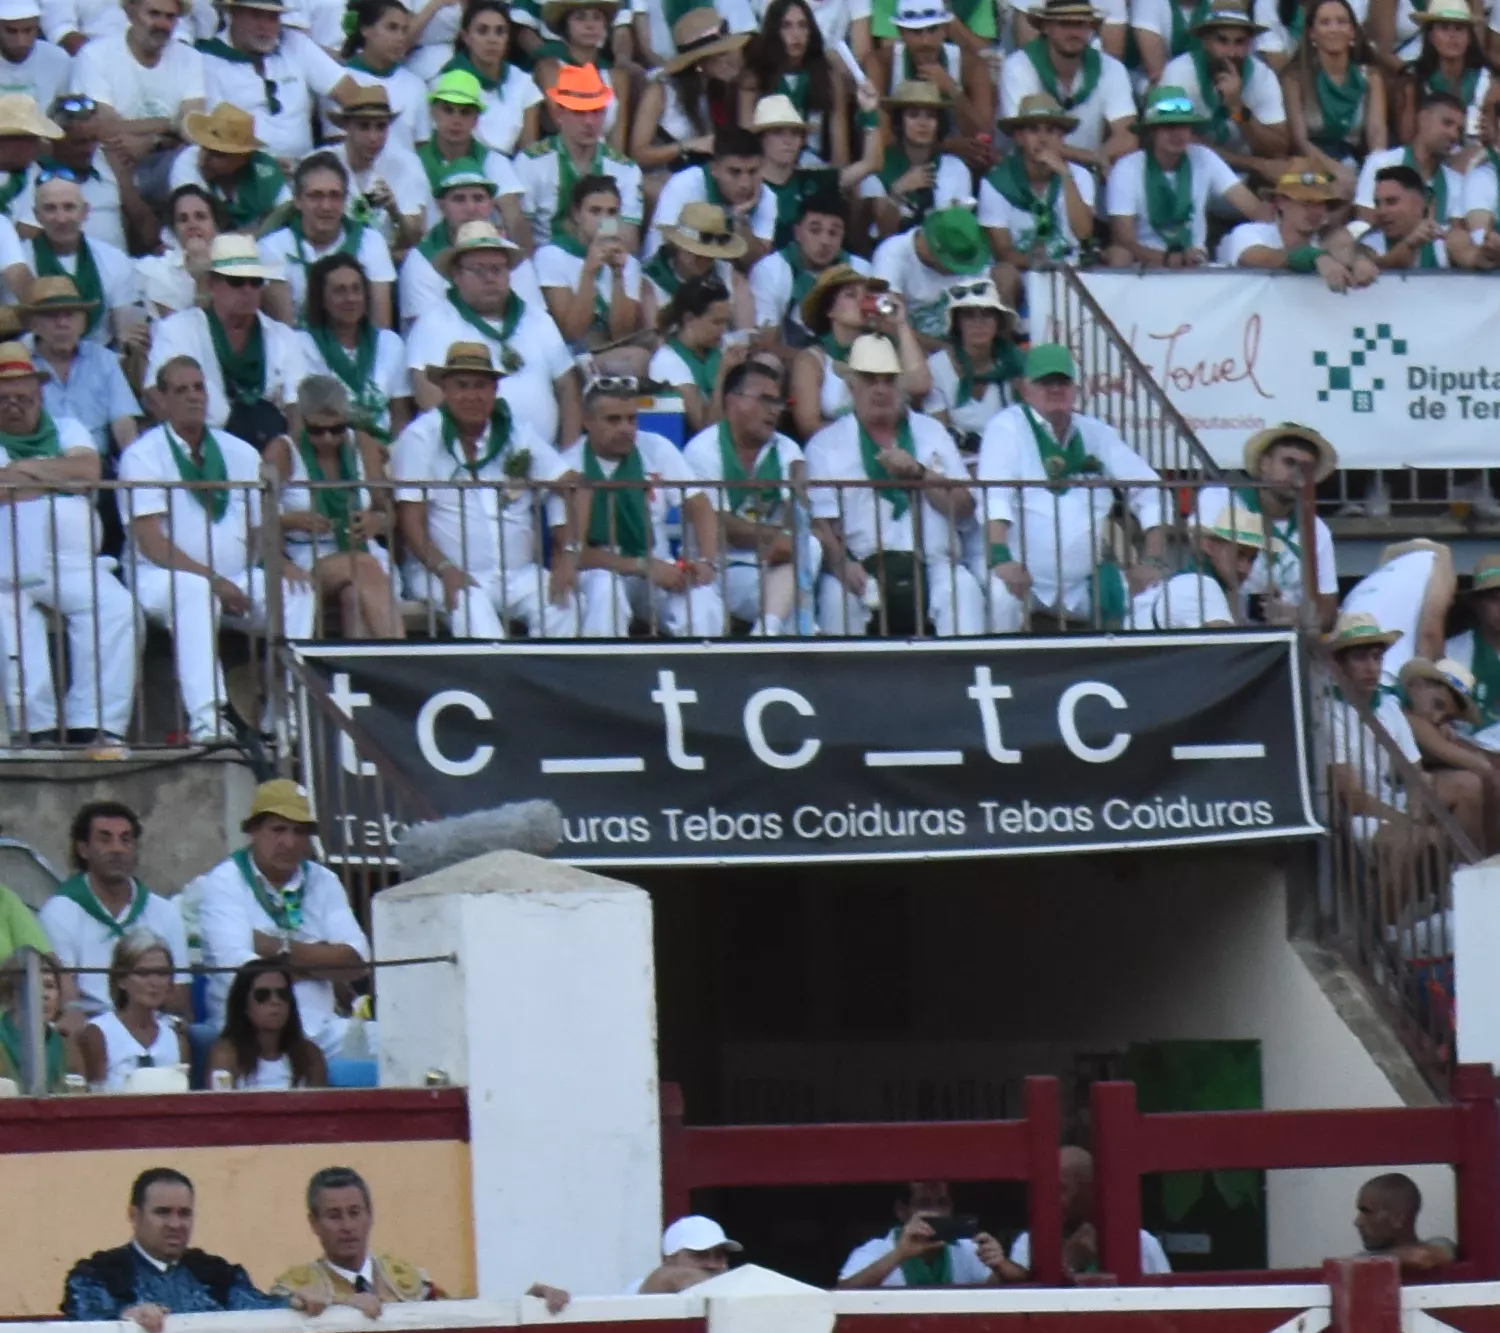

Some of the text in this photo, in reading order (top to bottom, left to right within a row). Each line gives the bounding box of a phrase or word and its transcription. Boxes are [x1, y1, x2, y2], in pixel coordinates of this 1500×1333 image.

[1408, 396, 1447, 420] de
[660, 807, 783, 842] Tebas
[793, 803, 967, 838] Coiduras
[979, 800, 1095, 834] Tebas
[1103, 796, 1274, 830] Coiduras
